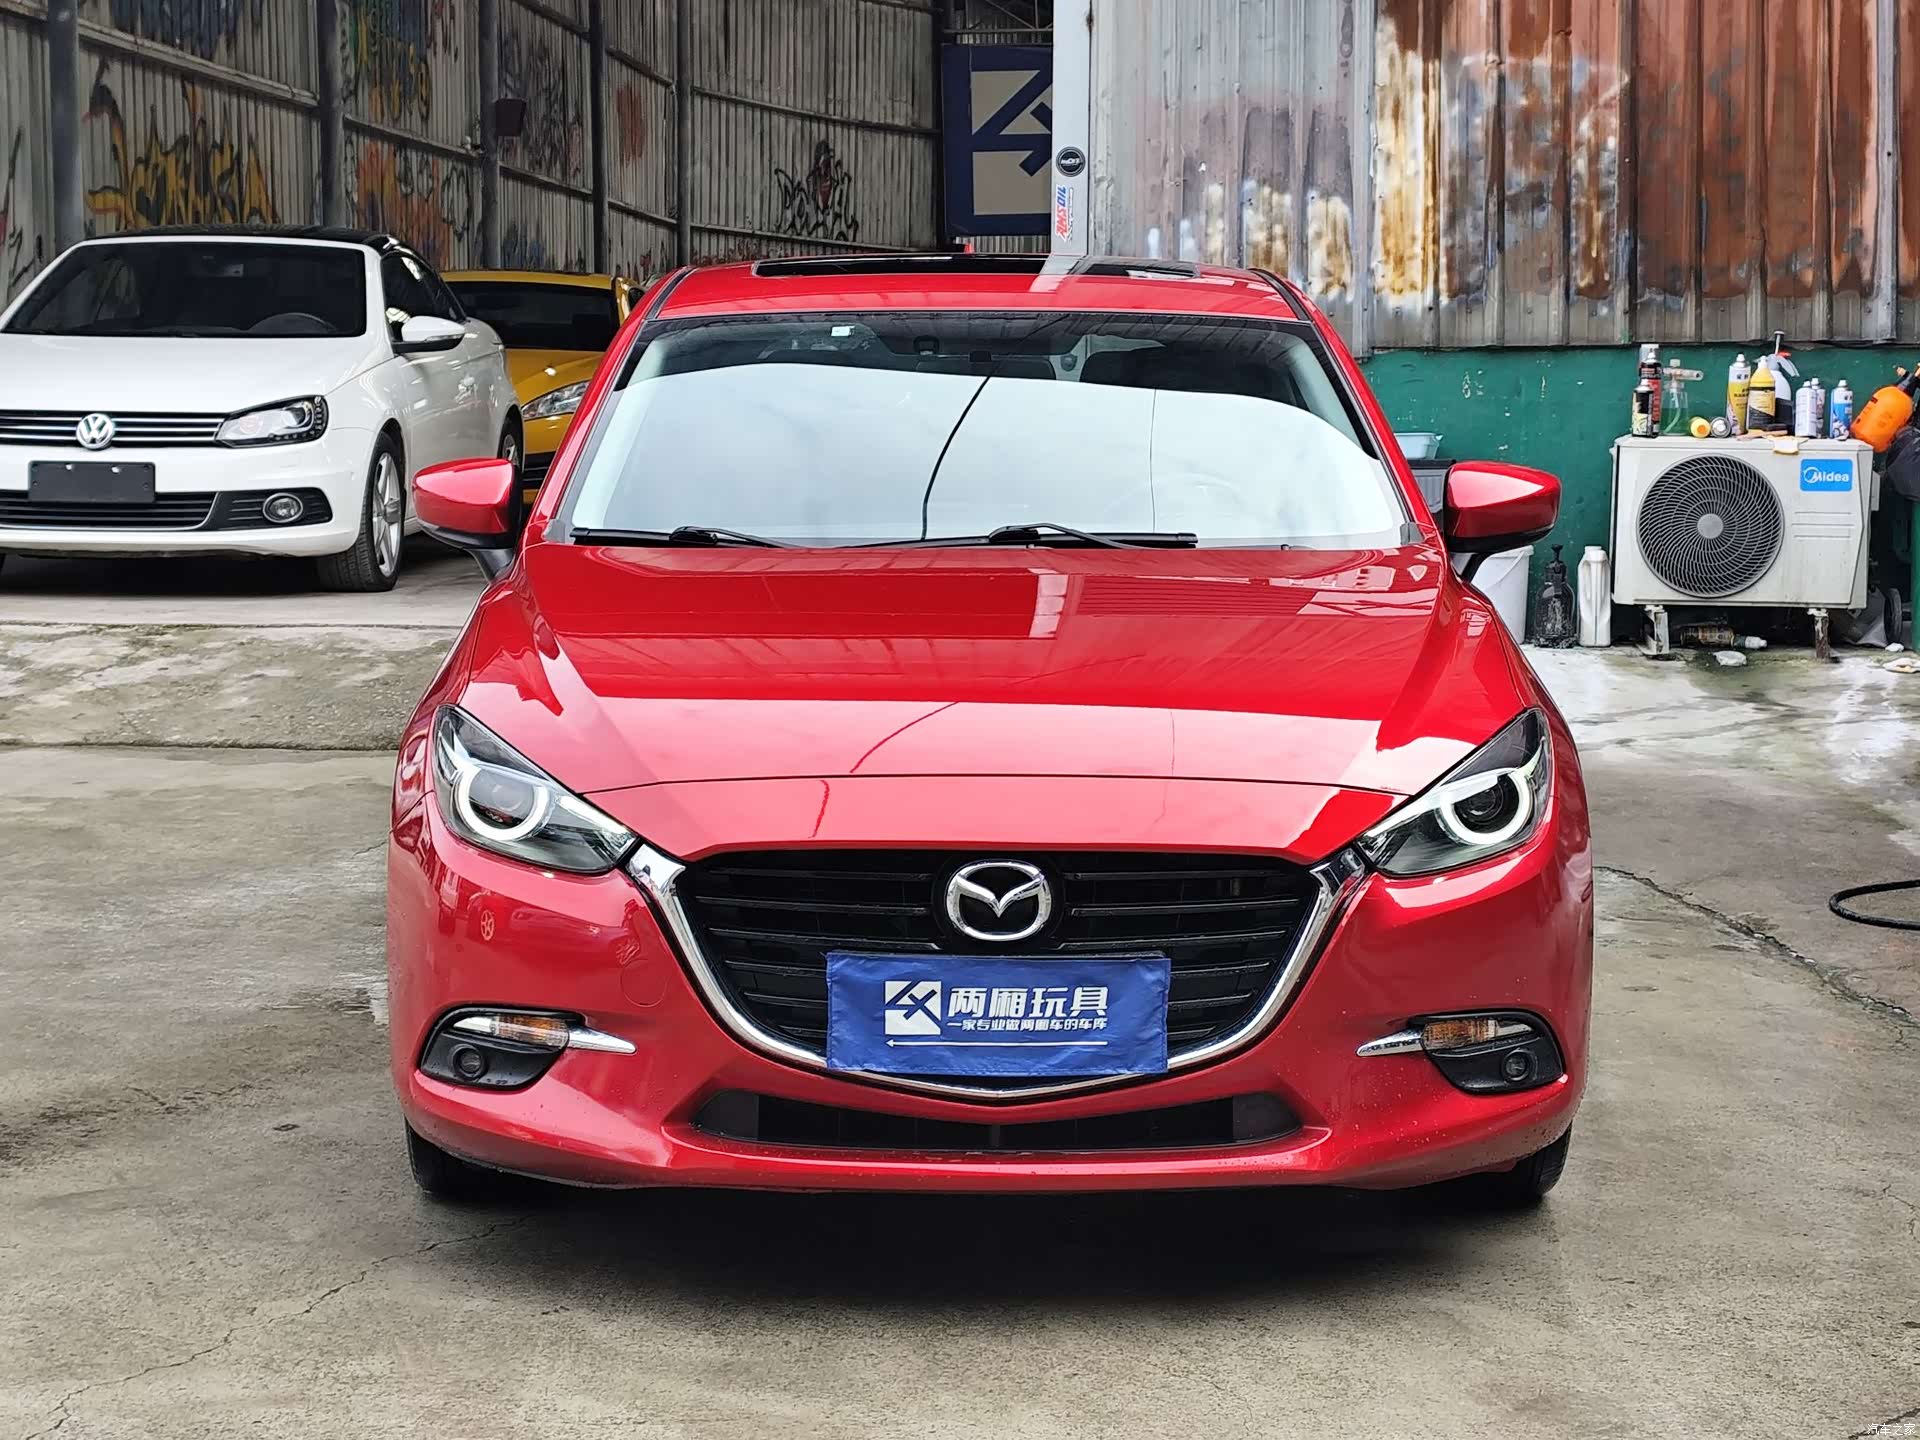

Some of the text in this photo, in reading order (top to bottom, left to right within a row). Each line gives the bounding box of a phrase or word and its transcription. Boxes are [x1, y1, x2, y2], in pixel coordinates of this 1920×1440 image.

[1055, 185, 1068, 239] AMSOIL
[1803, 466, 1849, 483] Midea
[947, 986, 1109, 1018] 两厢玩具
